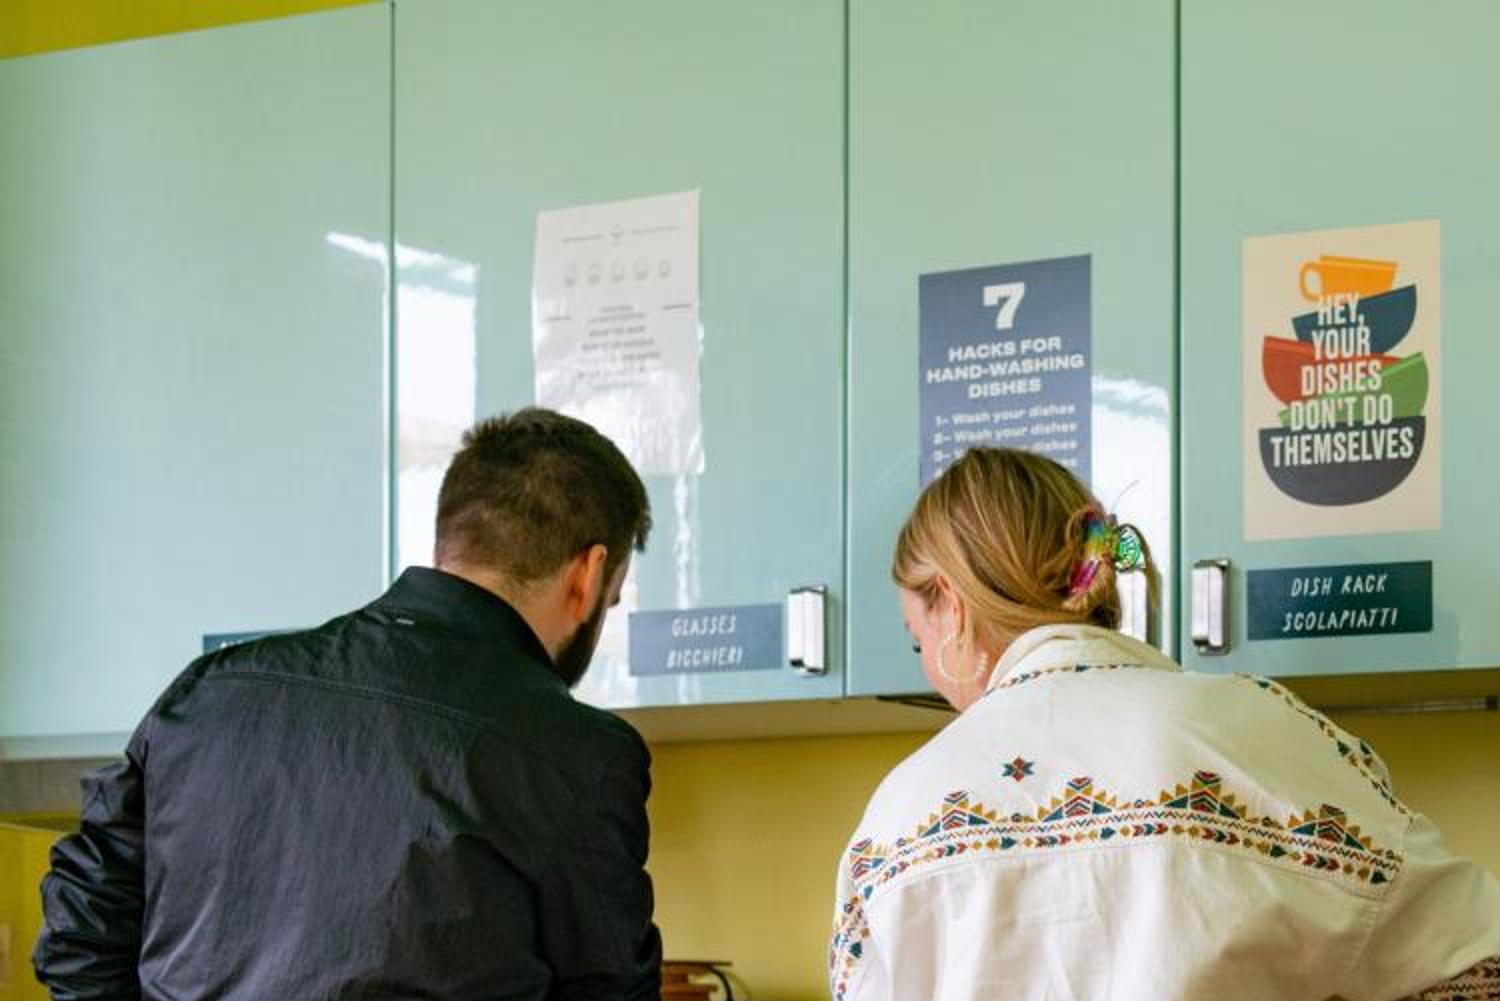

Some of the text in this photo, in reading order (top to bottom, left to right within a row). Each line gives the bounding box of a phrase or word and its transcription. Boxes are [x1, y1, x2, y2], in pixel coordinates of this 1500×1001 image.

[983, 282, 1025, 330] 7
[1317, 291, 1366, 326] HEY,
[948, 336, 1062, 363] HACKS FOR
[1312, 326, 1371, 360] YOUR
[926, 354, 1085, 384] HAND-WASHING
[1301, 359, 1382, 397] DISHES
[968, 378, 1041, 399] DISHES
[1029, 403, 1076, 417] dishes
[1290, 393, 1393, 432] DON'T DO
[1030, 421, 1077, 436] dishes
[1270, 427, 1414, 468] THEMSELVES
[1291, 574, 1388, 598] DISH RACK
[672, 615, 737, 637] GLASSES
[1282, 607, 1398, 633] SCOLAPIATTI
[666, 646, 743, 669] BICCHIERI
